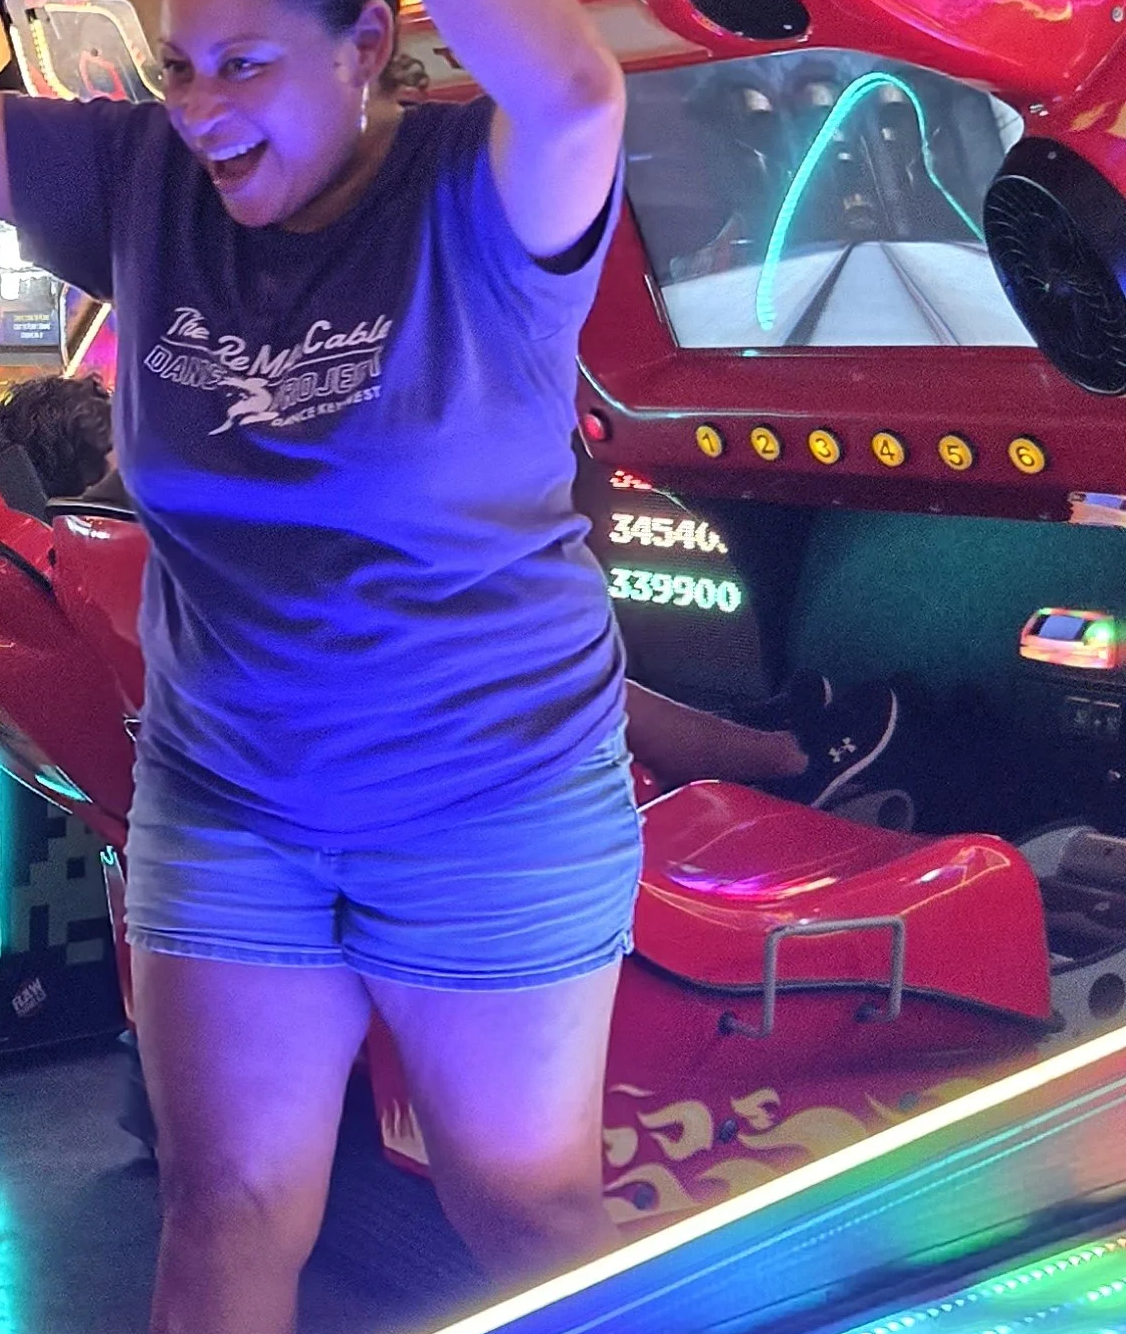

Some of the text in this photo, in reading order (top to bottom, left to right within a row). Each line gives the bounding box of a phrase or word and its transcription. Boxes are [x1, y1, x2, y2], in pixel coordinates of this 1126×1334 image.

[167, 307, 210, 340] The
[609, 513, 728, 553] 34540
[608, 568, 742, 612] 339900
